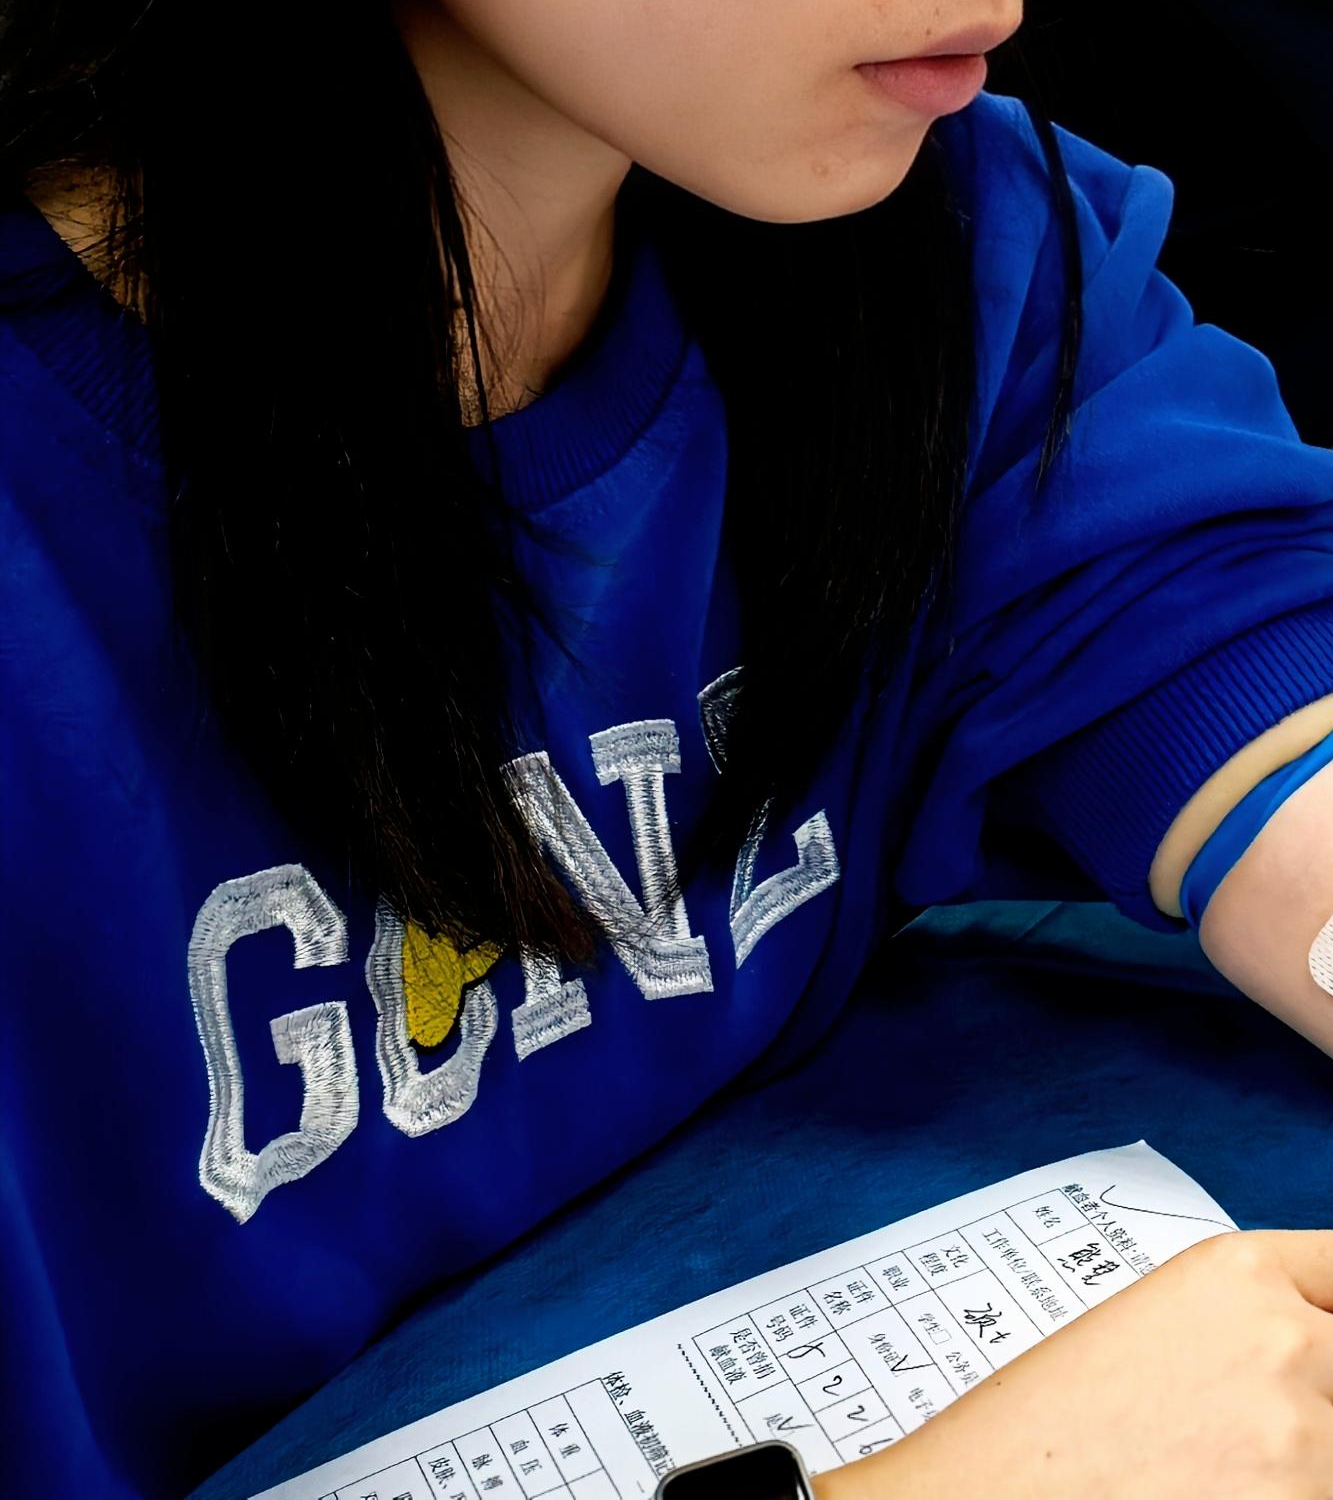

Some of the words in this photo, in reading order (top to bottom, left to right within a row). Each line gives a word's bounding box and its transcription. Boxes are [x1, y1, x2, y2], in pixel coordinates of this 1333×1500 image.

[1031, 1204, 1063, 1230] 姓名
[917, 1251, 949, 1279] 程度
[941, 1244, 972, 1269] 文化
[981, 1227, 1070, 1322] 工作单位/联系地址
[821, 1288, 853, 1317] 名称
[845, 1279, 877, 1306] 证件
[764, 1314, 795, 1344] 号码
[787, 1303, 821, 1332] 证件
[880, 1264, 912, 1292] 职业
[916, 1313, 944, 1336] 学生
[944, 1350, 981, 1387] 公务员
[708, 1341, 748, 1387] 献血液
[729, 1325, 777, 1381] 是否曾捐
[866, 1332, 902, 1366] 身份证
[508, 1436, 543, 1477] 血压
[547, 1421, 582, 1460] 体重
[470, 1452, 505, 1493] 脉搏
